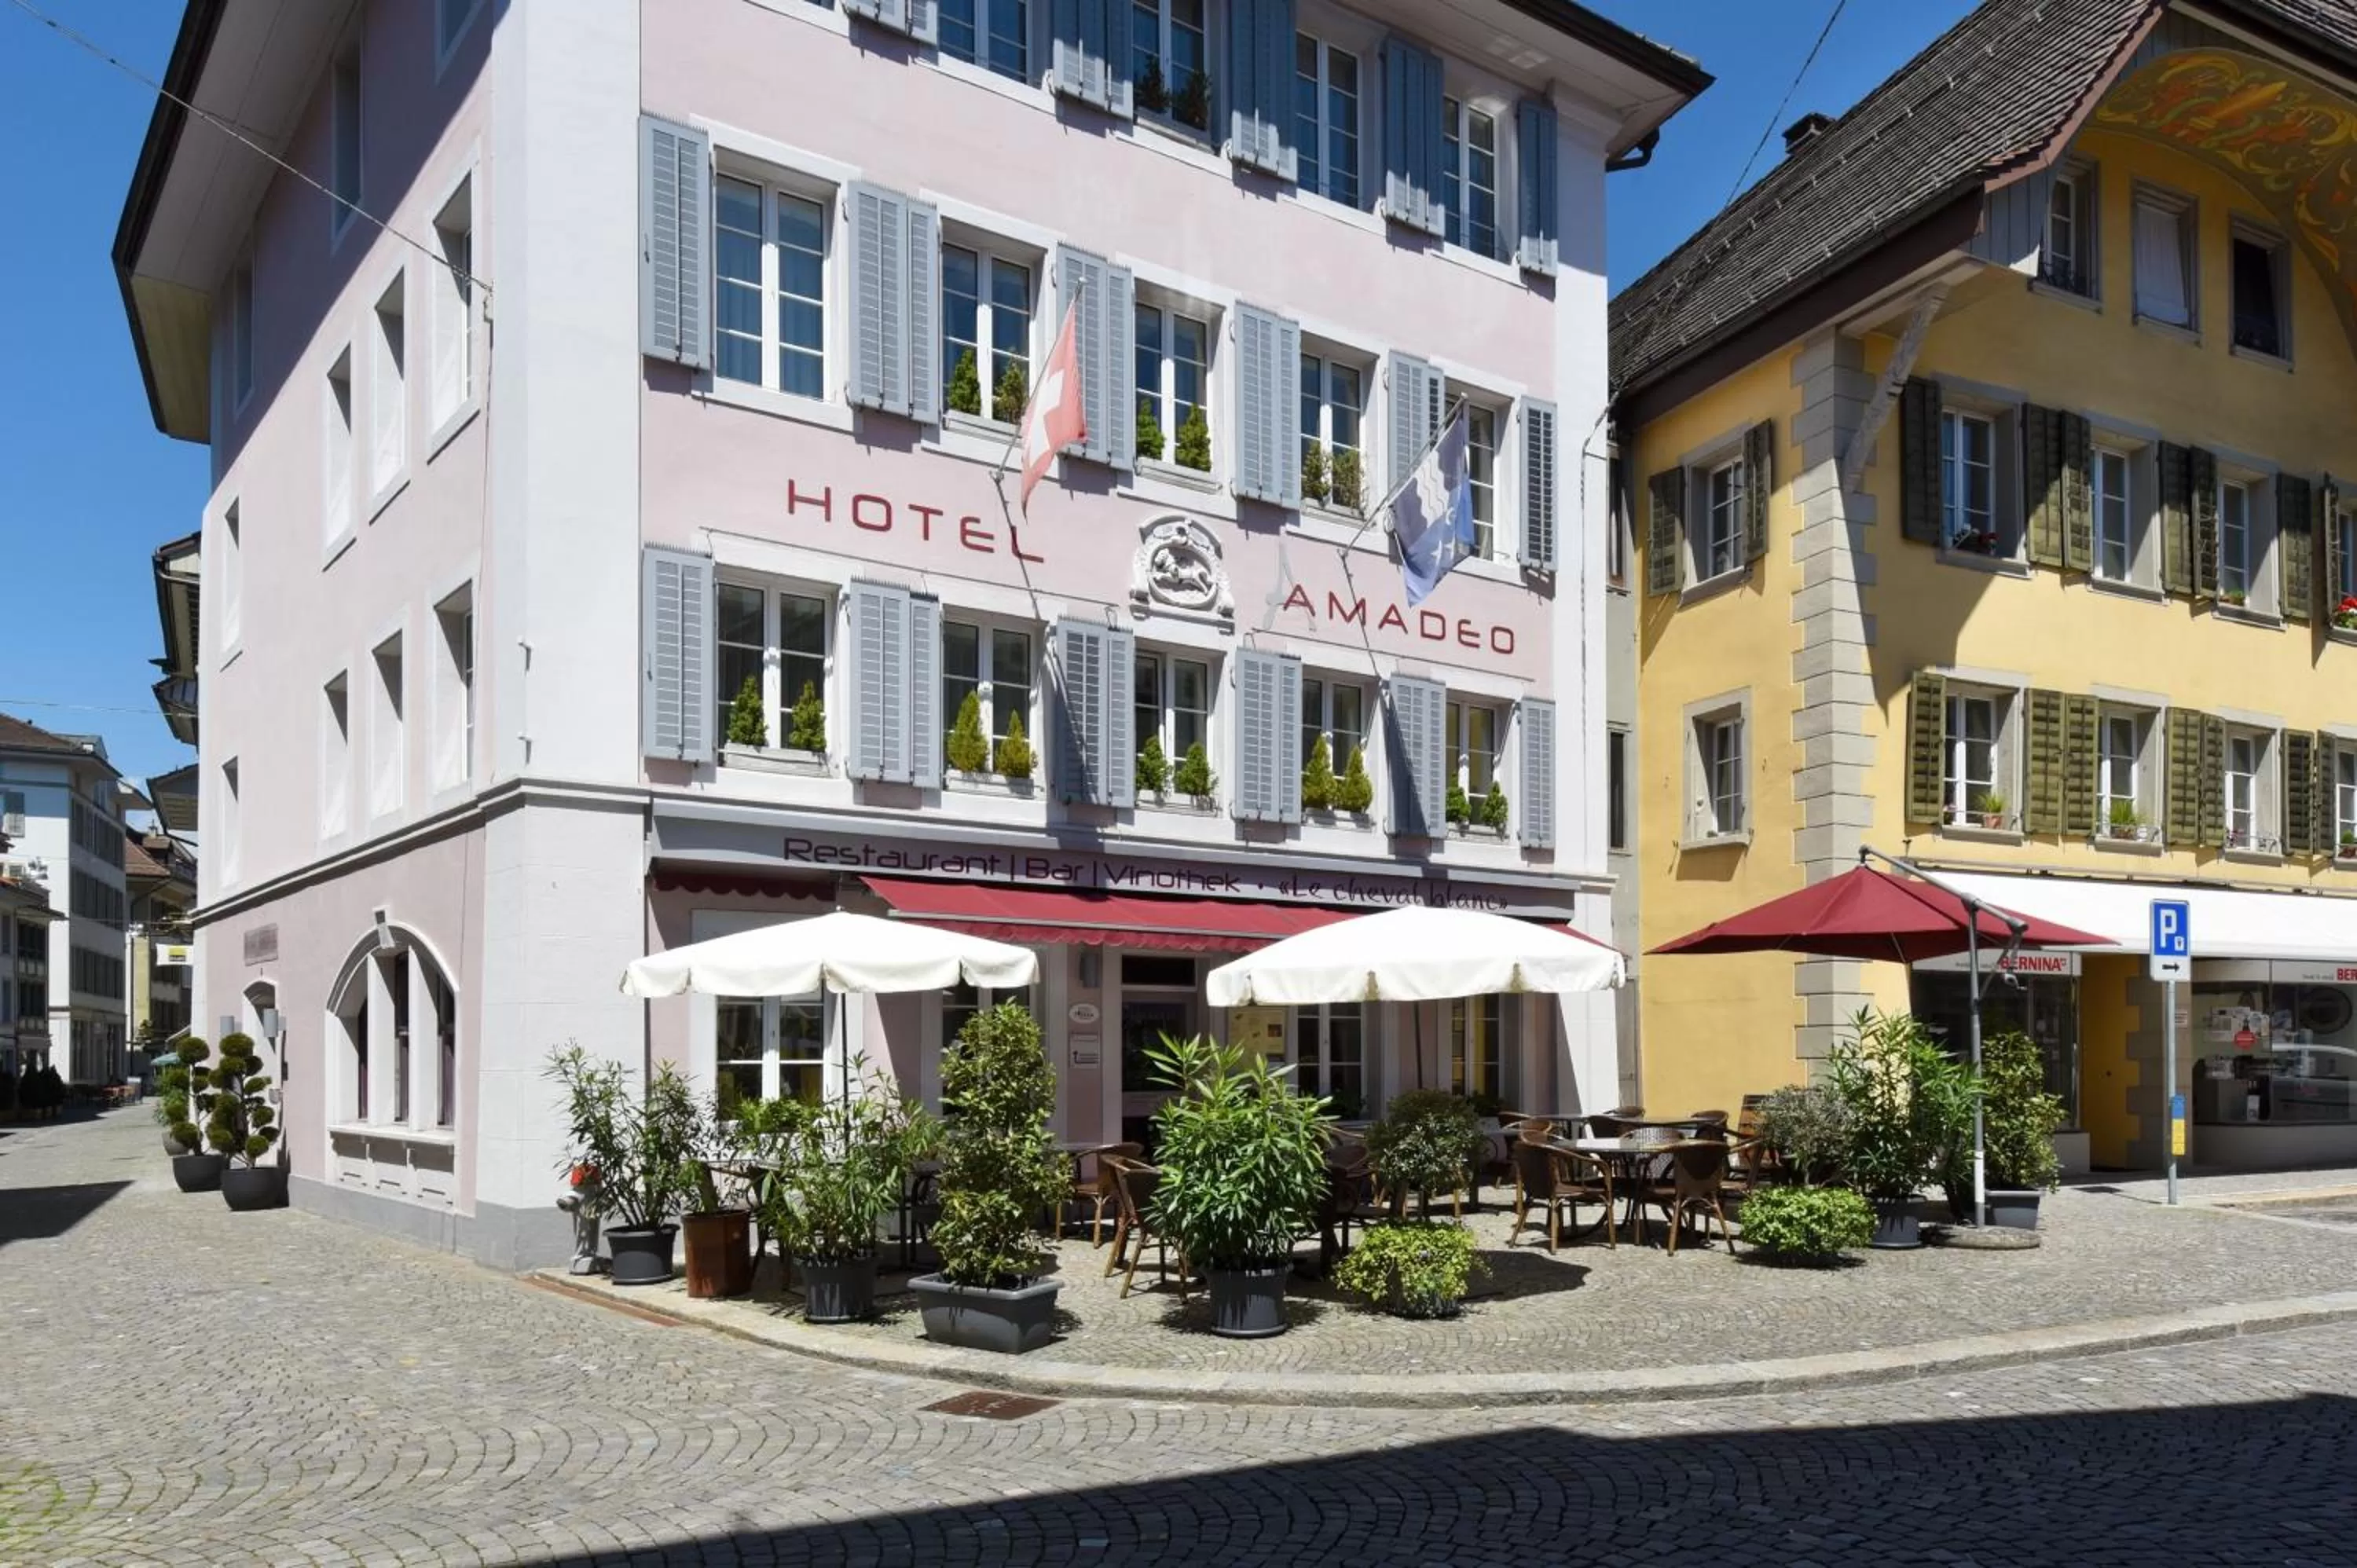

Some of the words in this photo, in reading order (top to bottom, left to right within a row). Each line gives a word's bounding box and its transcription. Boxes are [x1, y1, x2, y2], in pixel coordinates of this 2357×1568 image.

[788, 478, 1044, 563] HOTEL
[1283, 584, 1515, 654] AMADEO
[783, 837, 1000, 876] Restaurant
[1025, 857, 1086, 881] Bar
[1104, 861, 1241, 893] Vinothek
[2160, 908, 2177, 948] P
